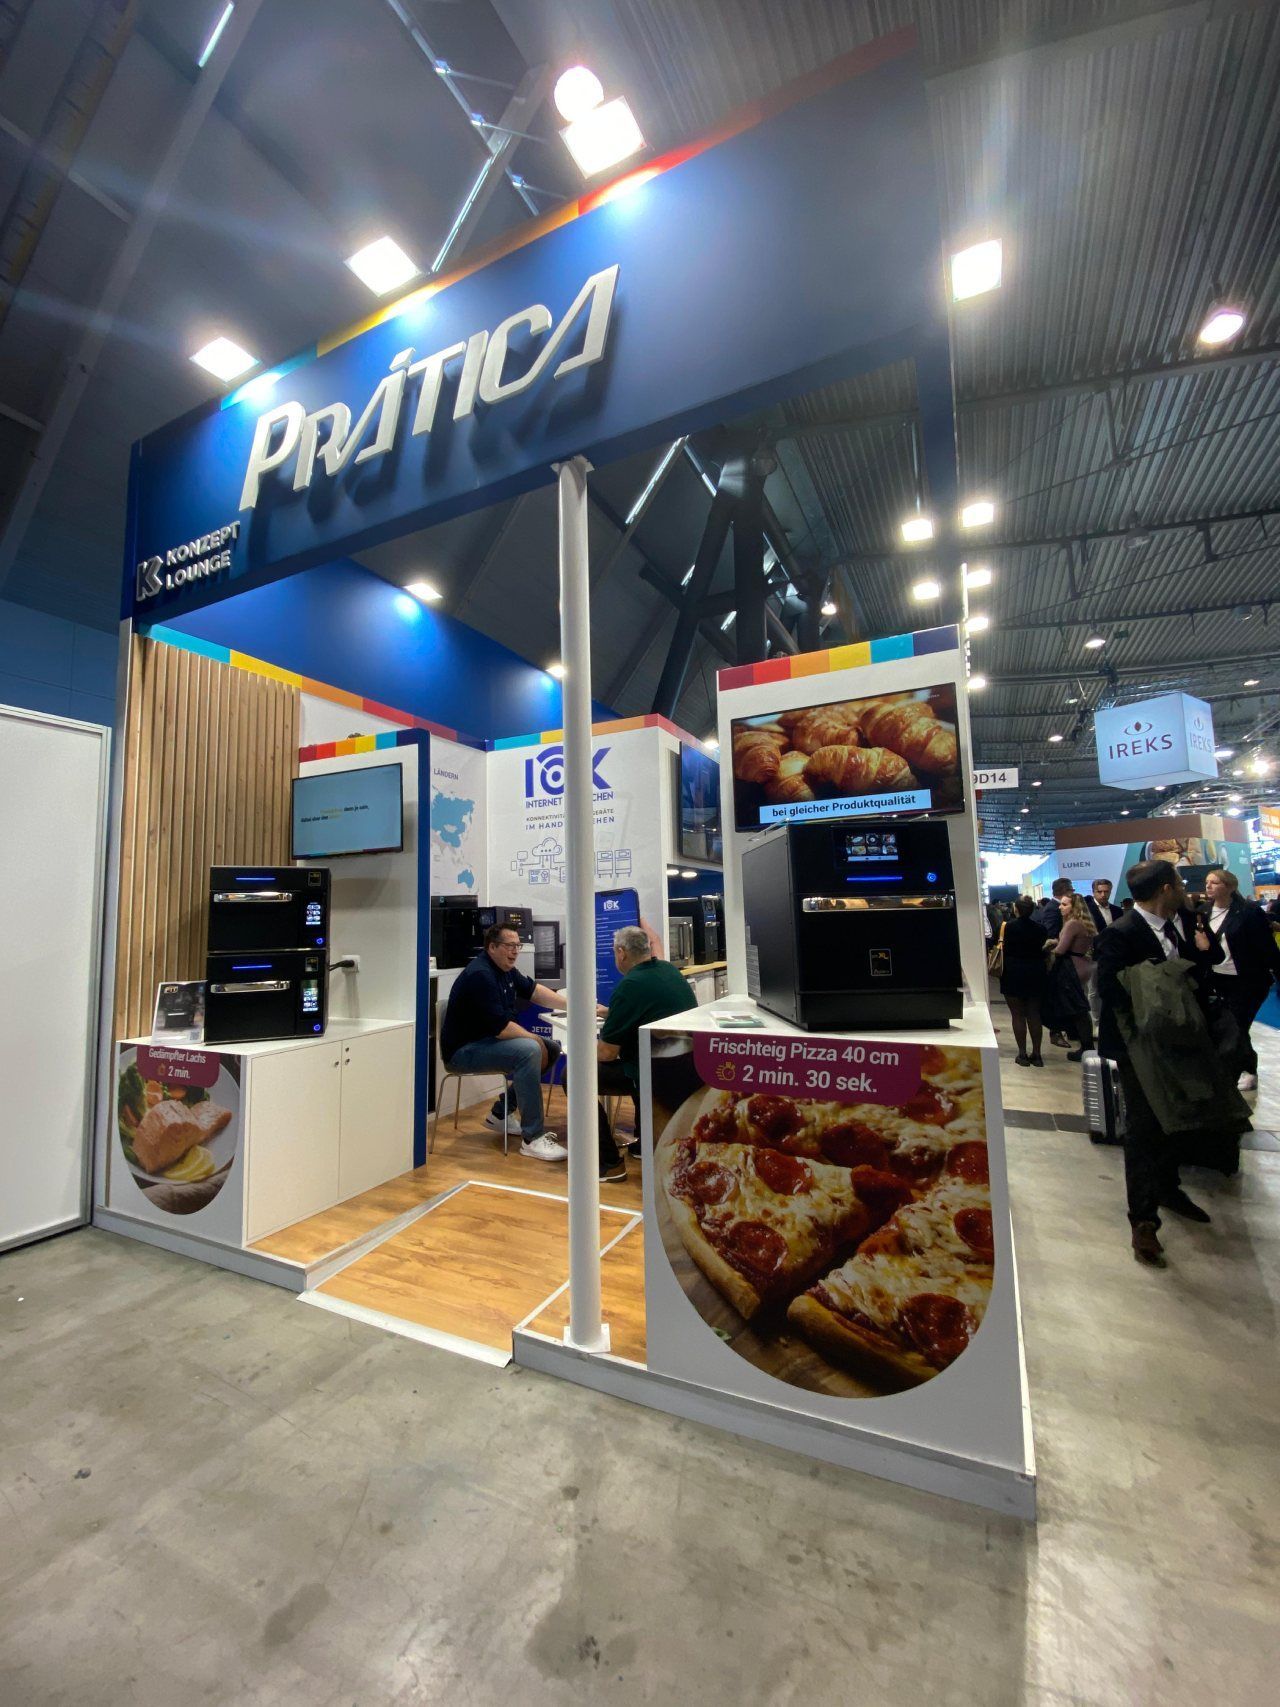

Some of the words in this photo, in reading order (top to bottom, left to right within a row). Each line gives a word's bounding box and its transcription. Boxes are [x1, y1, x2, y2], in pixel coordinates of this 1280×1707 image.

[239, 264, 620, 511] PRÁTICA
[166, 520, 240, 566] KONZEPT
[166, 549, 231, 590] LOUNGE
[1109, 733, 1173, 760] IREKS
[1189, 732, 1212, 753] IREKS
[434, 768, 459, 780] LÄNDERN
[525, 797, 562, 808] INTERNET
[772, 807, 788, 818] bei
[789, 801, 829, 817] gleicher
[832, 795, 917, 811] Produktqualität
[526, 814, 564, 822] KONNEKTIVIT
[1062, 860, 1091, 869] LUMEN
[531, 1026, 552, 1034] JETZT
[149, 1048, 185, 1062] Gedämpfter
[186, 1052, 206, 1063] Lachs
[709, 1037, 787, 1062] Frischteig
[790, 1042, 837, 1062] Pizza
[841, 1046, 866, 1063] 40
[869, 1051, 899, 1066] cm
[168, 1066, 174, 1077] 2
[175, 1067, 190, 1078] min.
[742, 1065, 754, 1082] 2
[758, 1066, 799, 1086] min.
[805, 1069, 831, 1089] 30
[835, 1072, 878, 1093] sek.
